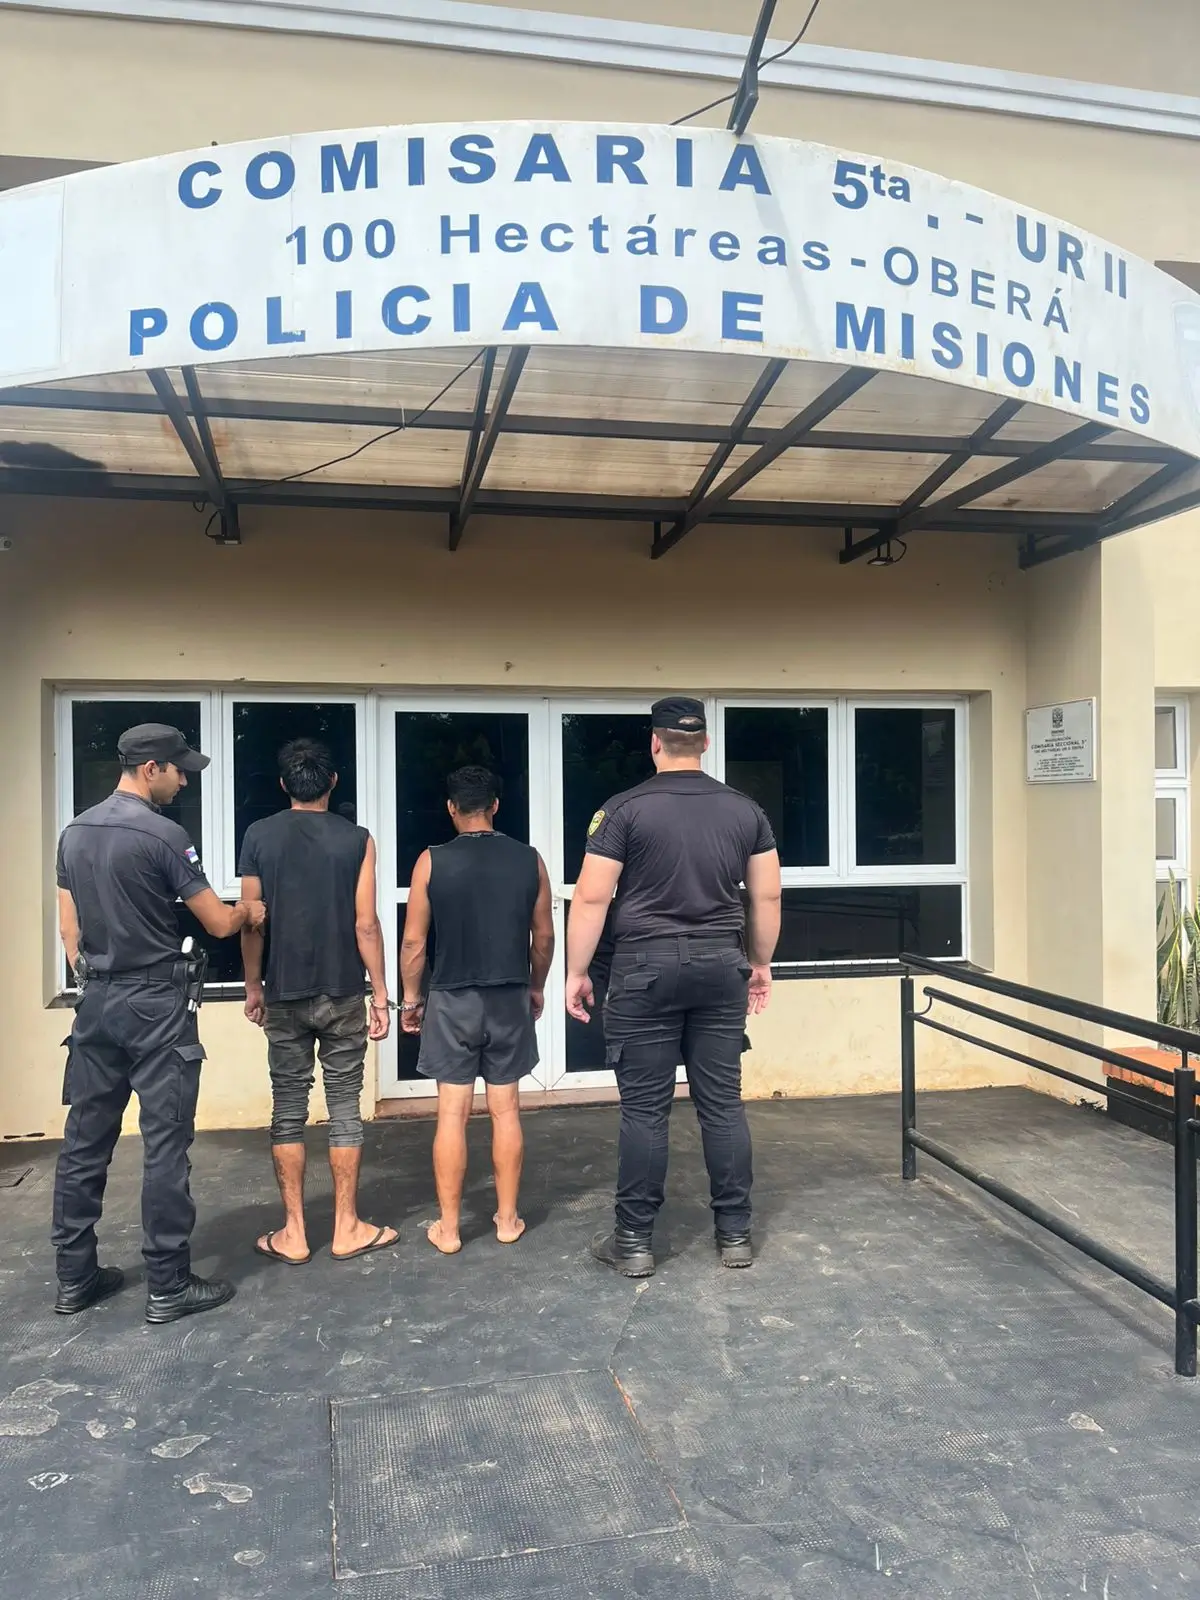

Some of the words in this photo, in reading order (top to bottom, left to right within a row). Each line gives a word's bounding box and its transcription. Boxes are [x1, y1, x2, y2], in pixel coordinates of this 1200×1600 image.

[178, 133, 771, 209] COMISARIA
[1016, 214, 1085, 281] UR
[286, 218, 396, 265] 100
[129, 281, 558, 356] POLICIA
[640, 285, 764, 342] DE
[835, 301, 1151, 425] MISIONES
